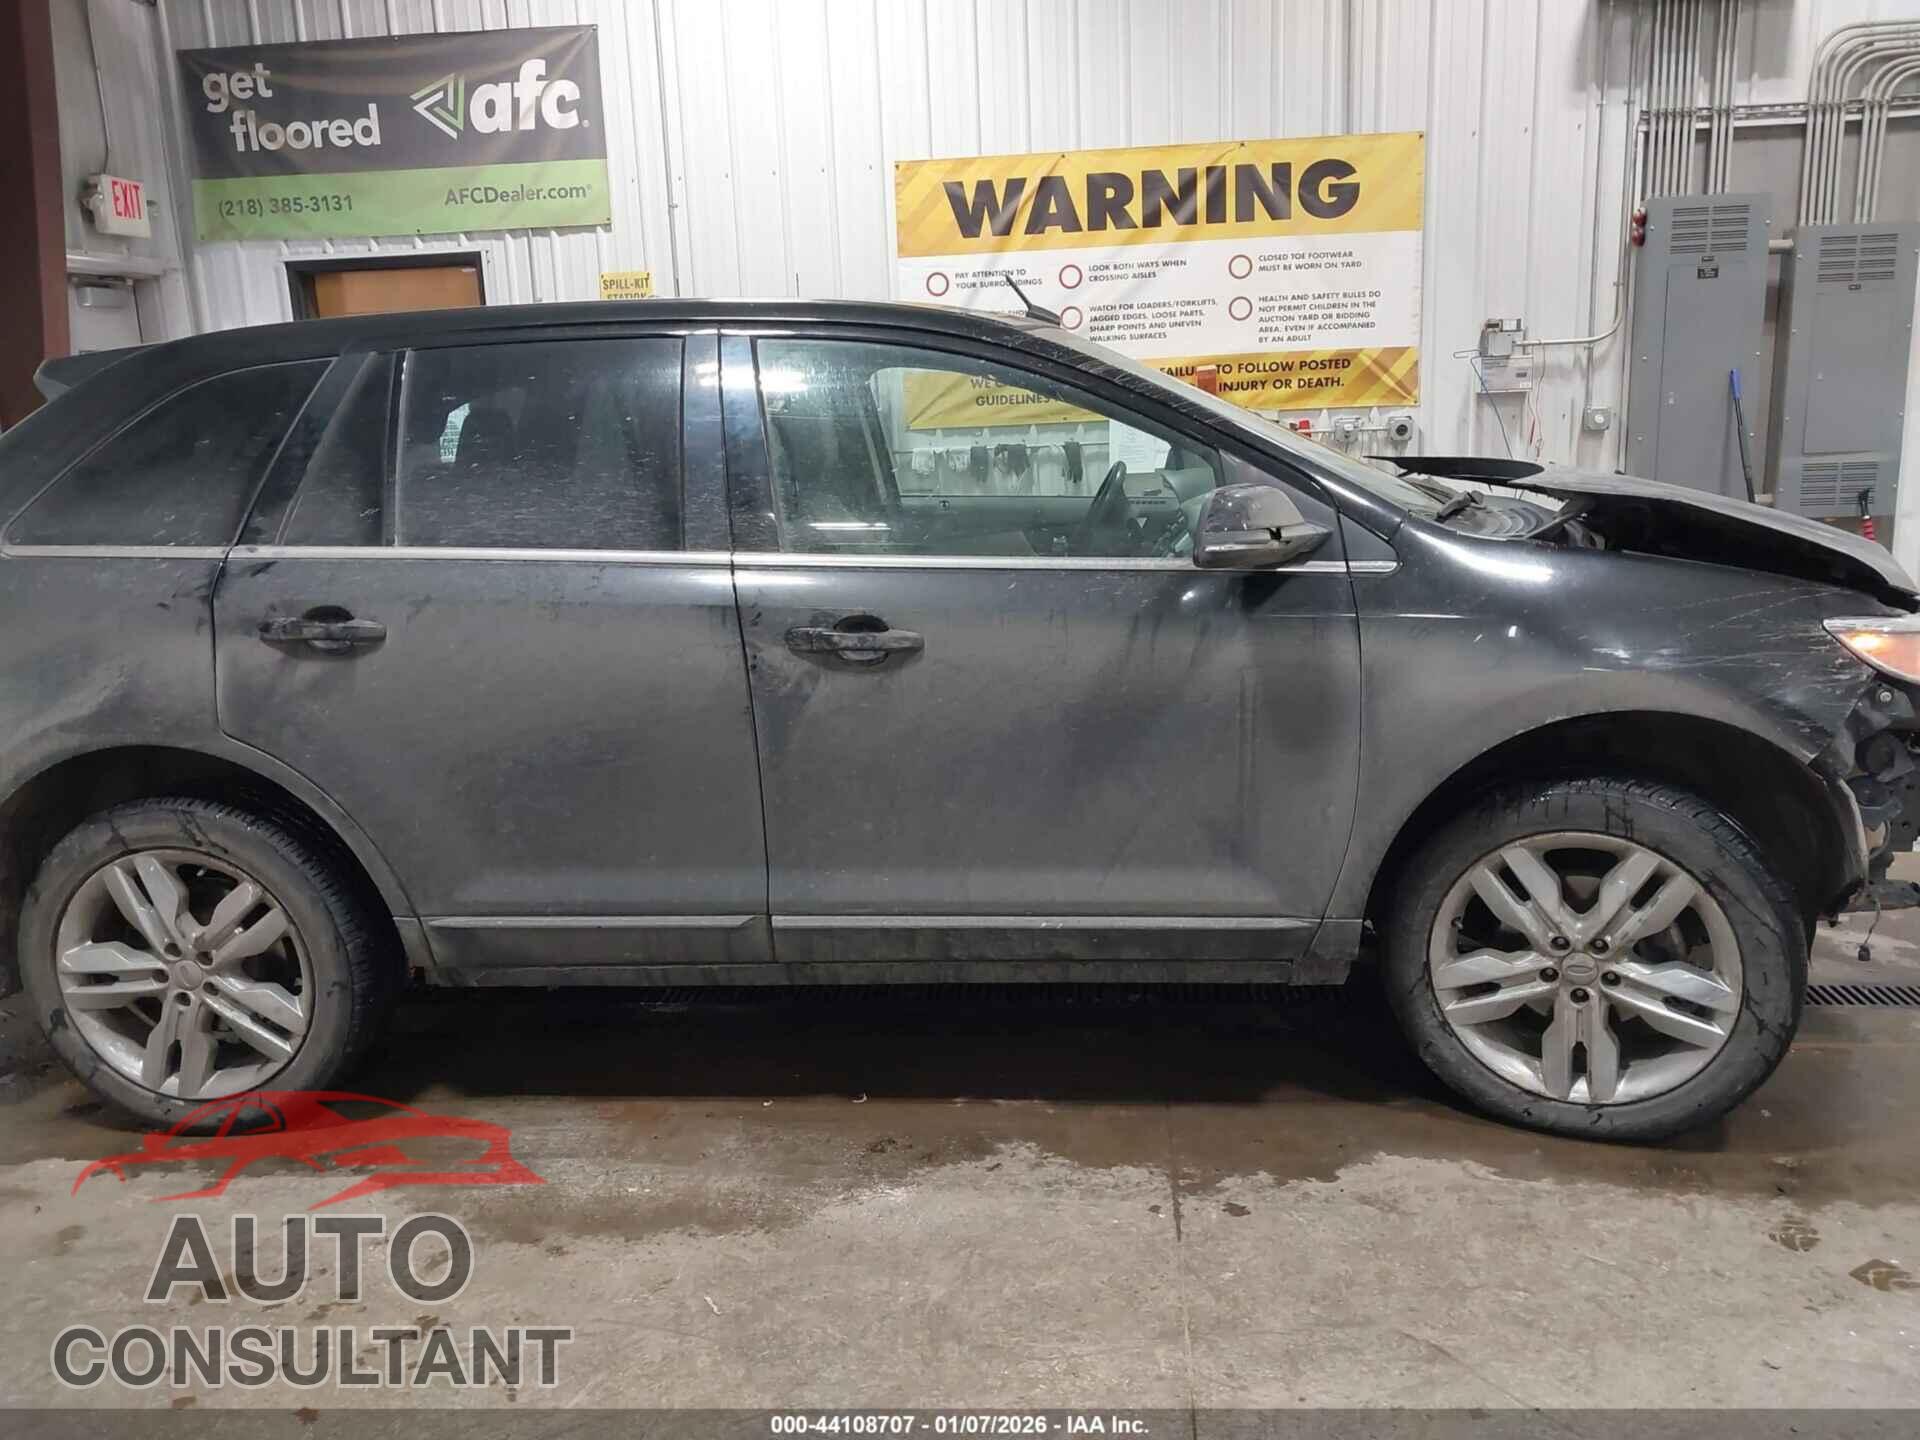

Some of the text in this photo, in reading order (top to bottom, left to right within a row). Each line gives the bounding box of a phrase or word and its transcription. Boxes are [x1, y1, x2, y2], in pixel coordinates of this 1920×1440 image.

[202, 63, 273, 113] get
[470, 59, 581, 133] afc
[229, 103, 382, 152] floored
[111, 180, 142, 220] EXIT
[444, 183, 588, 206] AFCDealer.com
[943, 158, 1360, 238] WARNING
[218, 194, 353, 219] (218) 385-3131
[1258, 254, 1288, 262] CLOSED
[1308, 251, 1353, 259] FOOTWEAR
[1089, 263, 1110, 272] LOOK
[1258, 264, 1280, 272] MUST
[1295, 262, 1322, 270] WORN
[955, 272, 969, 280] PAY
[972, 270, 1014, 278] ATTENTION
[1089, 271, 1157, 282] CROSSING AISLES
[602, 278, 649, 290] SPILL-KIT
[956, 279, 1042, 290] YOUR SURROUDINGS
[1258, 295, 1288, 303] HEALTH
[1312, 292, 1340, 300] SAFETY
[1342, 291, 1366, 299] RULES
[1368, 290, 1382, 298] DO
[1089, 304, 1117, 312] WATCH
[1119, 303, 1134, 311] FOR
[1258, 305, 1276, 313] NOT
[1278, 304, 1306, 312] PERMIT
[1309, 302, 1348, 311] CHILDREN
[1089, 313, 1120, 322] JAGGED
[1151, 311, 1176, 319] LOOSE
[1258, 315, 1295, 323] AUCTION
[1298, 313, 1319, 321] YARD
[1335, 311, 1370, 320] BIDDING
[1089, 320, 1202, 333] SHARP POINTS AND UNEVEN
[1284, 324, 1305, 332] EVEN
[1317, 322, 1376, 331] ACCOMPANIED
[1089, 332, 1167, 343] WALKING SURFACES
[1286, 334, 1312, 342] ADULT
[1216, 364, 1232, 375] TO
[1238, 361, 1295, 373] FOLLOW
[1300, 358, 1351, 371] POSTED
[1218, 377, 1344, 392] INJURY OR DEATH.
